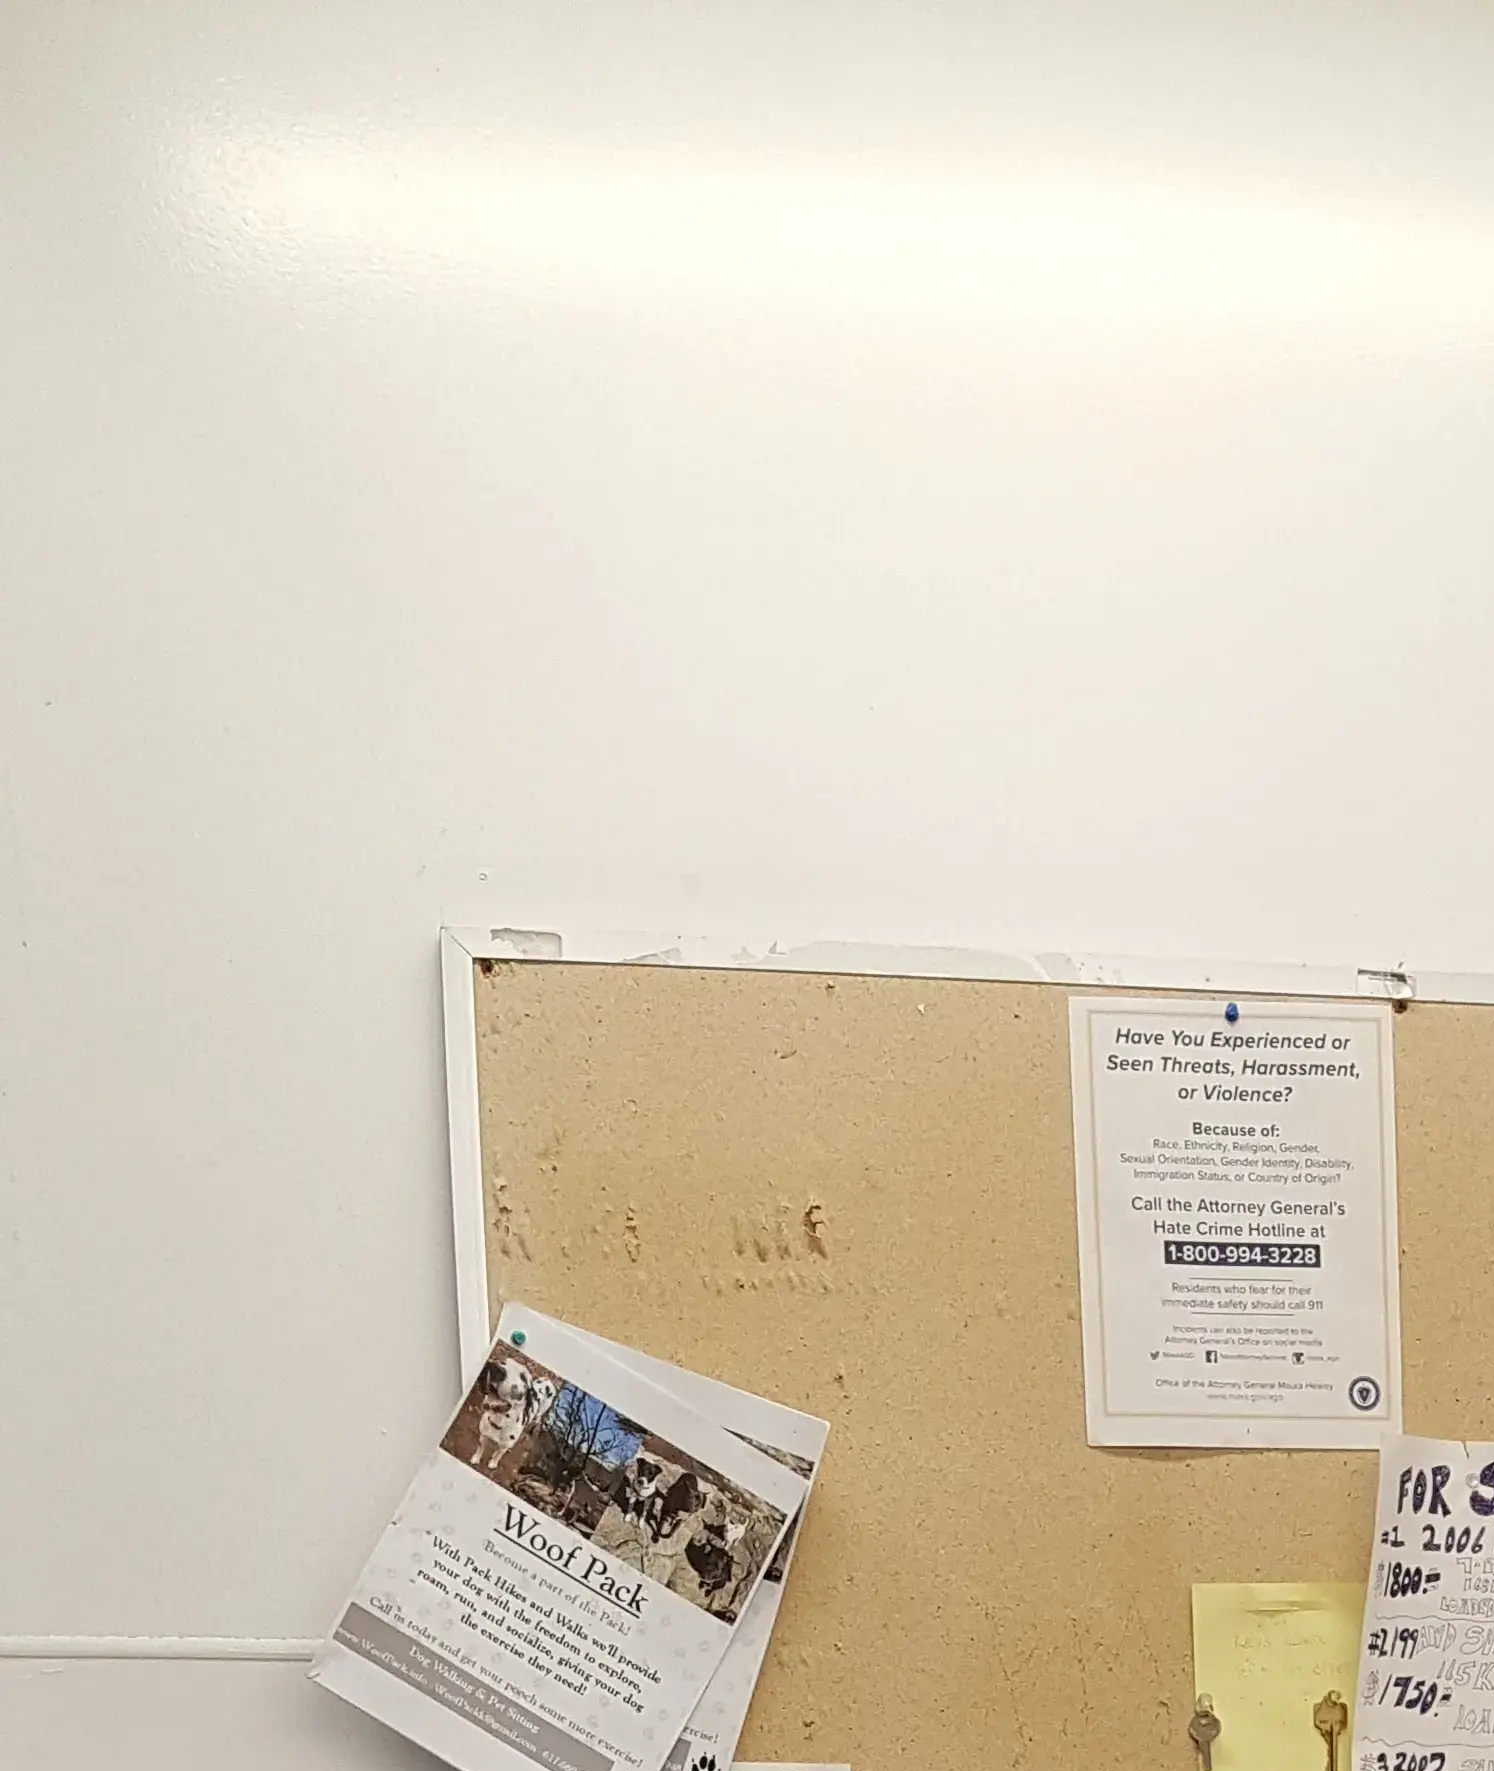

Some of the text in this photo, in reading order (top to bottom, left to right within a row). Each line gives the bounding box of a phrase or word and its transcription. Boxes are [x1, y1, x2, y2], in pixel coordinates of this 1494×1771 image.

[1115, 1027, 1352, 1052] Have You Experienced or
[1105, 1053, 1360, 1080] Seen Threats, Harassment,
[1177, 1083, 1293, 1103] or Violence?
[1191, 1121, 1280, 1138] Because of:
[1130, 1195, 1346, 1217] Call the Attorney General's
[1153, 1219, 1326, 1238] Hate Crime Hotline at
[1167, 1243, 1317, 1265] 1-800-994-3228
[1397, 1465, 1451, 1519] FOR
[1422, 1523, 1486, 1554] 2006
[504, 1502, 649, 1614] Woof Pack
[432, 1535, 662, 1684] With Pack Hikes and Walks we'll provide
[432, 1559, 642, 1694] your dog with the freedom to explore,
[416, 1569, 645, 1714] roam, run, and socialize, giving your dog
[459, 1612, 588, 1696] the exercise they need!
